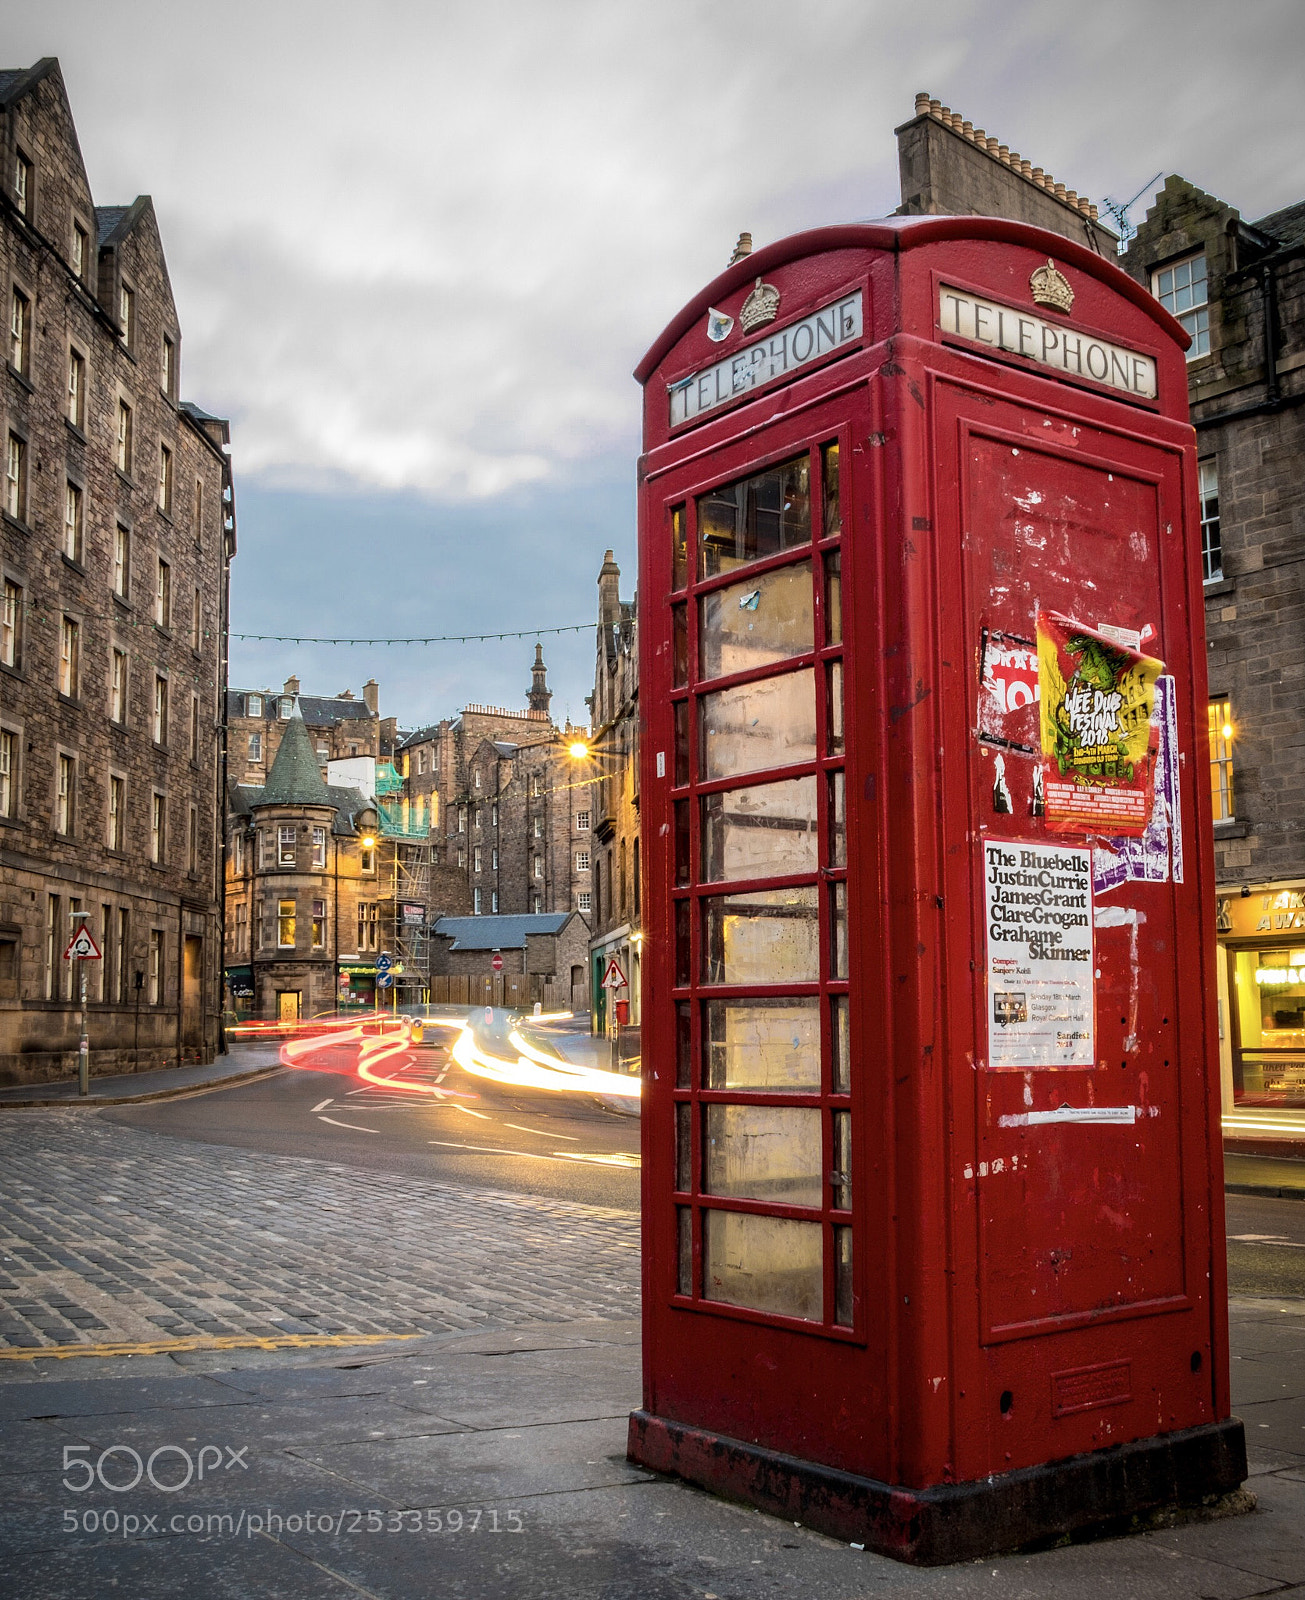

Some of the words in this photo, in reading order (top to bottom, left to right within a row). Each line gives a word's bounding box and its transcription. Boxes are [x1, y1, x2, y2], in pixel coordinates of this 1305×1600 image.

[947, 294, 1148, 395] TELEPHONE
[678, 299, 856, 418] TELEPHONE
[1065, 687, 1092, 712] WEE
[1094, 690, 1122, 713] DUB
[1070, 710, 1118, 732] FESTIVAL
[1081, 728, 1109, 747] 2018
[986, 847, 1016, 866] The
[1020, 850, 1089, 872] Bluebells
[989, 924, 1062, 943] Grahame
[1028, 941, 1090, 961] Skinner
[1031, 1003, 1056, 1012] Glasgow
[1031, 1014, 1048, 1023] Royal
[1073, 1014, 1084, 1022] Hall
[1056, 1031, 1090, 1040] Sandfest
